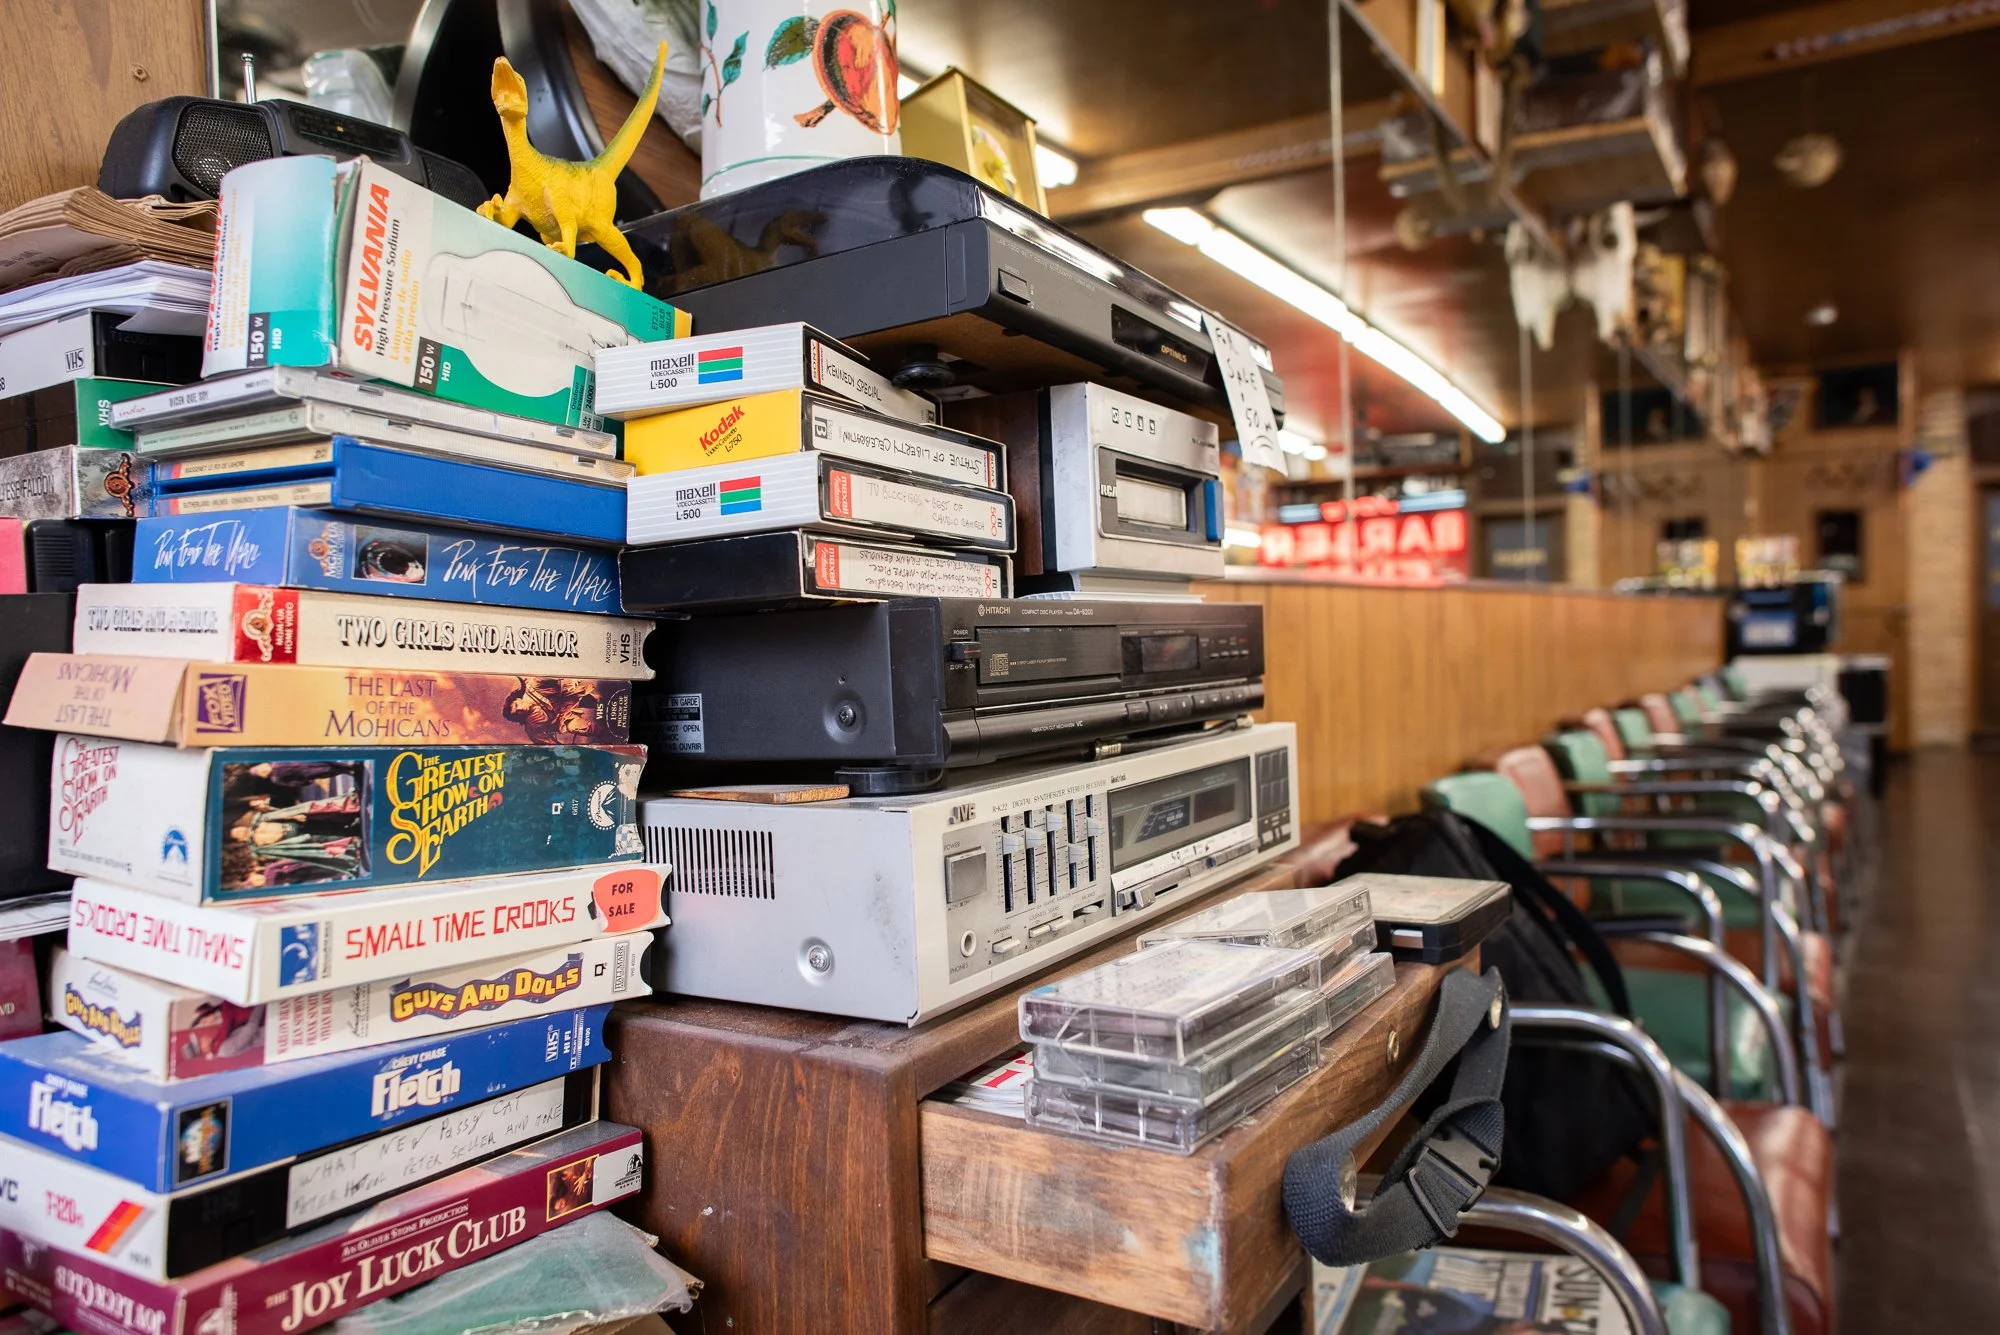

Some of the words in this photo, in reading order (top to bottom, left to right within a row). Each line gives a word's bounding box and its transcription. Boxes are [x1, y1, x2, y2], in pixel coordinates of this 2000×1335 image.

[387, 219, 400, 267] Sodium
[353, 183, 390, 352] SYLVANIA
[400, 249, 412, 286] sodio
[378, 270, 395, 324] Pressure
[398, 290, 406, 303] de
[407, 280, 420, 328] presión
[254, 316, 264, 328] W
[249, 330, 265, 362] 150
[272, 328, 282, 350] HID
[375, 326, 389, 357] High
[404, 330, 413, 354] alta
[425, 344, 436, 355] W
[65, 349, 84, 370] VHS
[650, 353, 695, 371] maxell
[1161, 344, 1188, 363] OPTIMUS
[418, 358, 436, 385] 150
[441, 361, 452, 382] HID
[651, 366, 695, 378] VIDEOCASSETTE
[571, 381, 580, 410] Outdoor
[577, 384, 585, 411] Exterior
[585, 384, 594, 410] 24000
[856, 378, 882, 401] SPECIAL
[98, 399, 111, 427] VHS
[699, 404, 745, 451] Kodak
[843, 430, 891, 451] CELEBRATION
[725, 433, 743, 453] L-750
[892, 441, 930, 461] LIBERTY
[931, 450, 944, 463] OF
[949, 453, 982, 474] STATUE
[22, 474, 55, 499] FALCON
[676, 483, 716, 501] maxell
[866, 482, 881, 497] TV
[1100, 483, 1117, 498] RCA
[676, 497, 716, 508] VIDEOCASSETTE
[989, 505, 998, 537] 500
[325, 521, 340, 578] MGM/UA
[442, 538, 486, 598] PINK
[486, 544, 530, 588] FLOYD
[522, 546, 575, 593] THE
[565, 550, 616, 606] WALL
[984, 567, 992, 598] 500
[285, 601, 295, 627] VIDEO
[985, 606, 1011, 615] HITACHI
[1021, 608, 1040, 616] COMPACT
[275, 608, 285, 646] MGM/UA
[284, 627, 293, 654] HOME
[336, 615, 387, 648] TWO
[391, 617, 455, 651] GIRLS
[459, 623, 500, 654] AND
[501, 626, 517, 655] A
[518, 627, 580, 659] SAILOR
[620, 633, 630, 664] VHS
[57, 661, 139, 694] MOHICANS
[344, 676, 384, 697] THE
[389, 678, 437, 698] LAST
[55, 703, 89, 724] LAST
[205, 680, 223, 726] FOX
[218, 682, 236, 728] VIDEO
[366, 700, 384, 714] OF
[388, 701, 415, 715] THE
[595, 703, 604, 720] VHS
[609, 701, 618, 721] 1986
[618, 696, 625, 707] OF
[680, 697, 698, 706] GARDE
[88, 706, 113, 728] THE
[324, 709, 451, 738] MOHICANS
[60, 737, 120, 783] GREATEST
[679, 742, 702, 751] OUVRIR
[102, 765, 117, 783] ON
[423, 754, 440, 767] THE
[386, 751, 505, 808] GREATEST
[478, 770, 505, 792] ON
[949, 803, 976, 825] JVC
[1012, 797, 1032, 809] DIGITAL
[1033, 789, 1066, 805] SYNTHESIZER
[1067, 783, 1085, 795] STEREO
[1085, 779, 1106, 792] RECEIVER
[417, 798, 490, 878] EARTH
[943, 841, 961, 851] POWER
[612, 882, 634, 896] FOR
[75, 898, 139, 942] CROOKS
[608, 902, 636, 918] SALE
[143, 915, 183, 953] TIME
[345, 919, 427, 961] SMALL
[493, 896, 577, 935] CROOKS
[187, 927, 245, 970] SMALL
[613, 944, 625, 992] HALLMARK
[950, 961, 969, 975] PHONES
[391, 989, 456, 1021] GUYS
[457, 981, 509, 1012] AND
[515, 965, 579, 998] DOLLS
[66, 991, 90, 1024] GUYS
[88, 1006, 111, 1033] AND
[109, 1012, 142, 1047] DOLLS
[546, 1030, 560, 1063] VHS
[563, 1042, 571, 1053] HI
[564, 1030, 572, 1041] FI
[393, 1053, 416, 1070] CHEVY
[418, 1046, 447, 1065] CHASE
[372, 1061, 461, 1118] Fletch
[28, 1080, 99, 1152] Fletch
[302, 1143, 369, 1187] WHAT
[380, 1125, 433, 1156] NEW
[492, 1090, 528, 1116] CAT
[450, 1134, 497, 1161] SELLER
[506, 1117, 531, 1136] AND
[535, 1102, 563, 1125] MORE
[357, 1229, 391, 1251] OLIVER
[391, 1221, 418, 1241] STONE
[418, 1203, 469, 1231] PRODUCTION
[54, 1263, 91, 1301] CLUB
[266, 1289, 290, 1309] THE
[281, 1271, 354, 1332] JOY
[356, 1235, 445, 1300] LUCK
[447, 1205, 526, 1259] CLUB
[88, 1277, 132, 1319] LUCK
[131, 1299, 166, 1335] JOY
